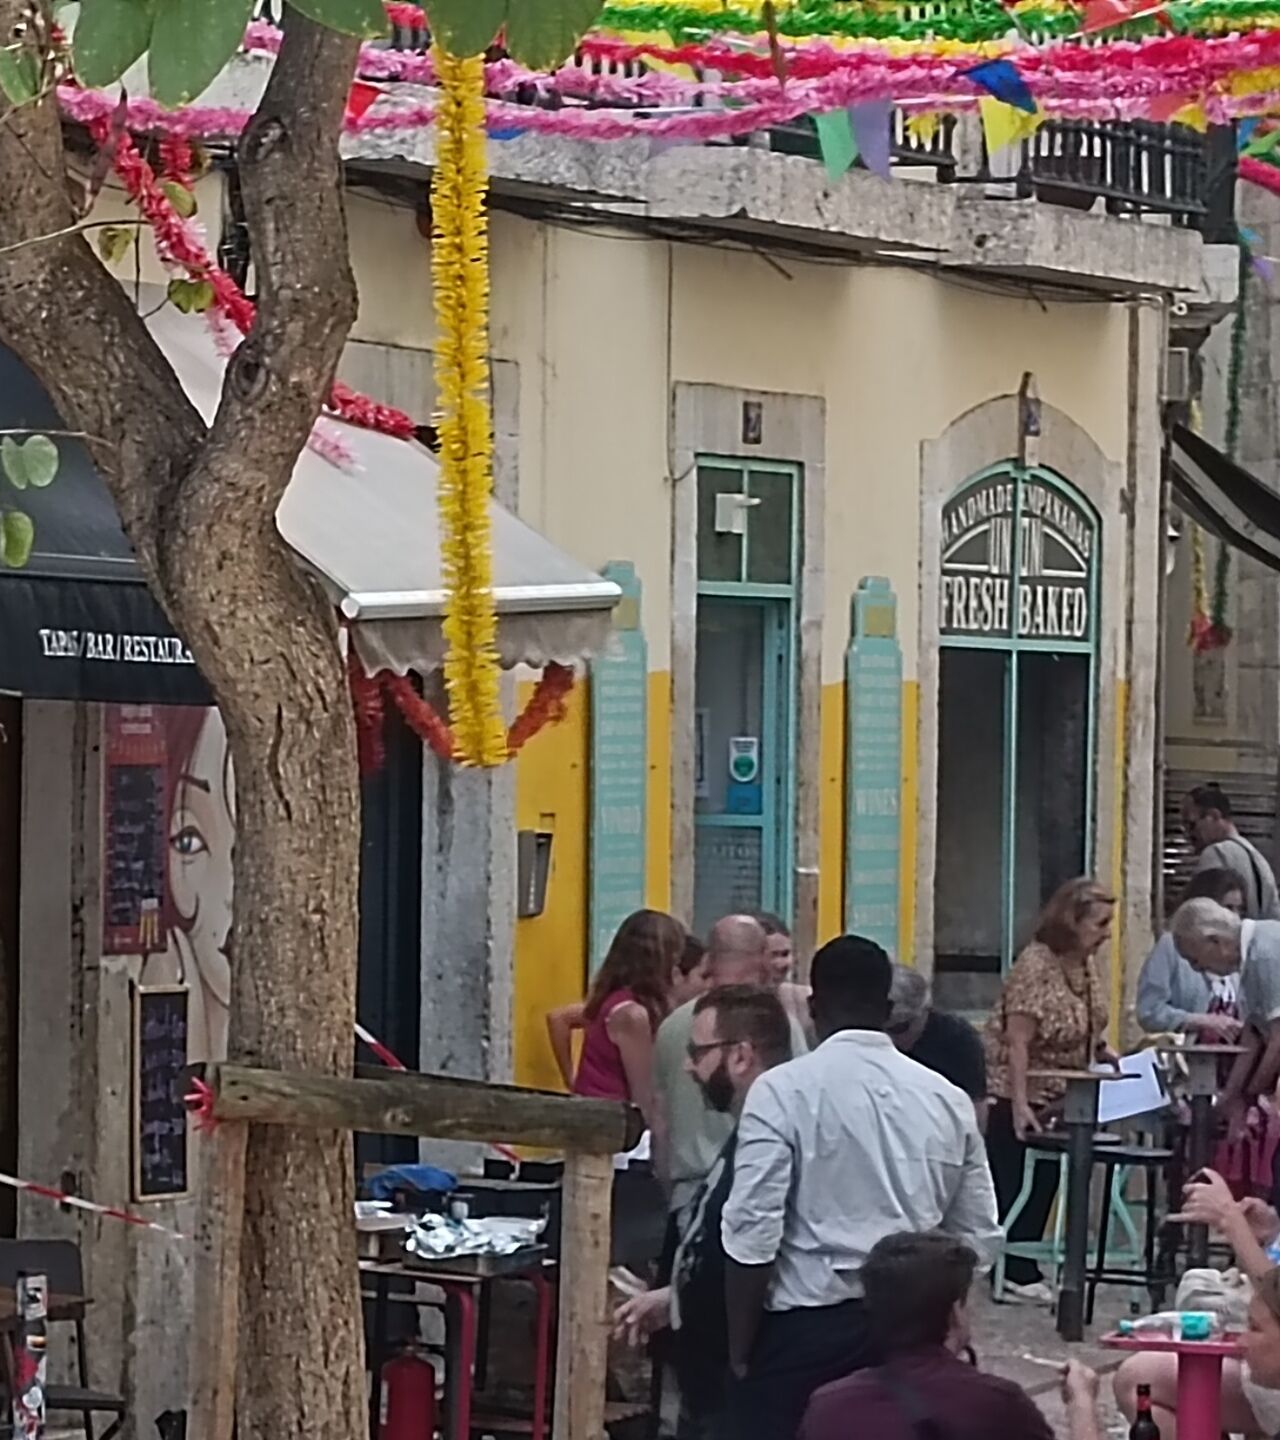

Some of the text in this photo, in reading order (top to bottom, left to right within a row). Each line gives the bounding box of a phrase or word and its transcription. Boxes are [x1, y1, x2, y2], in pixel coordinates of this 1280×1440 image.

[942, 484, 1014, 545] HANDMADE
[940, 575, 1086, 637] FRESH BAKED
